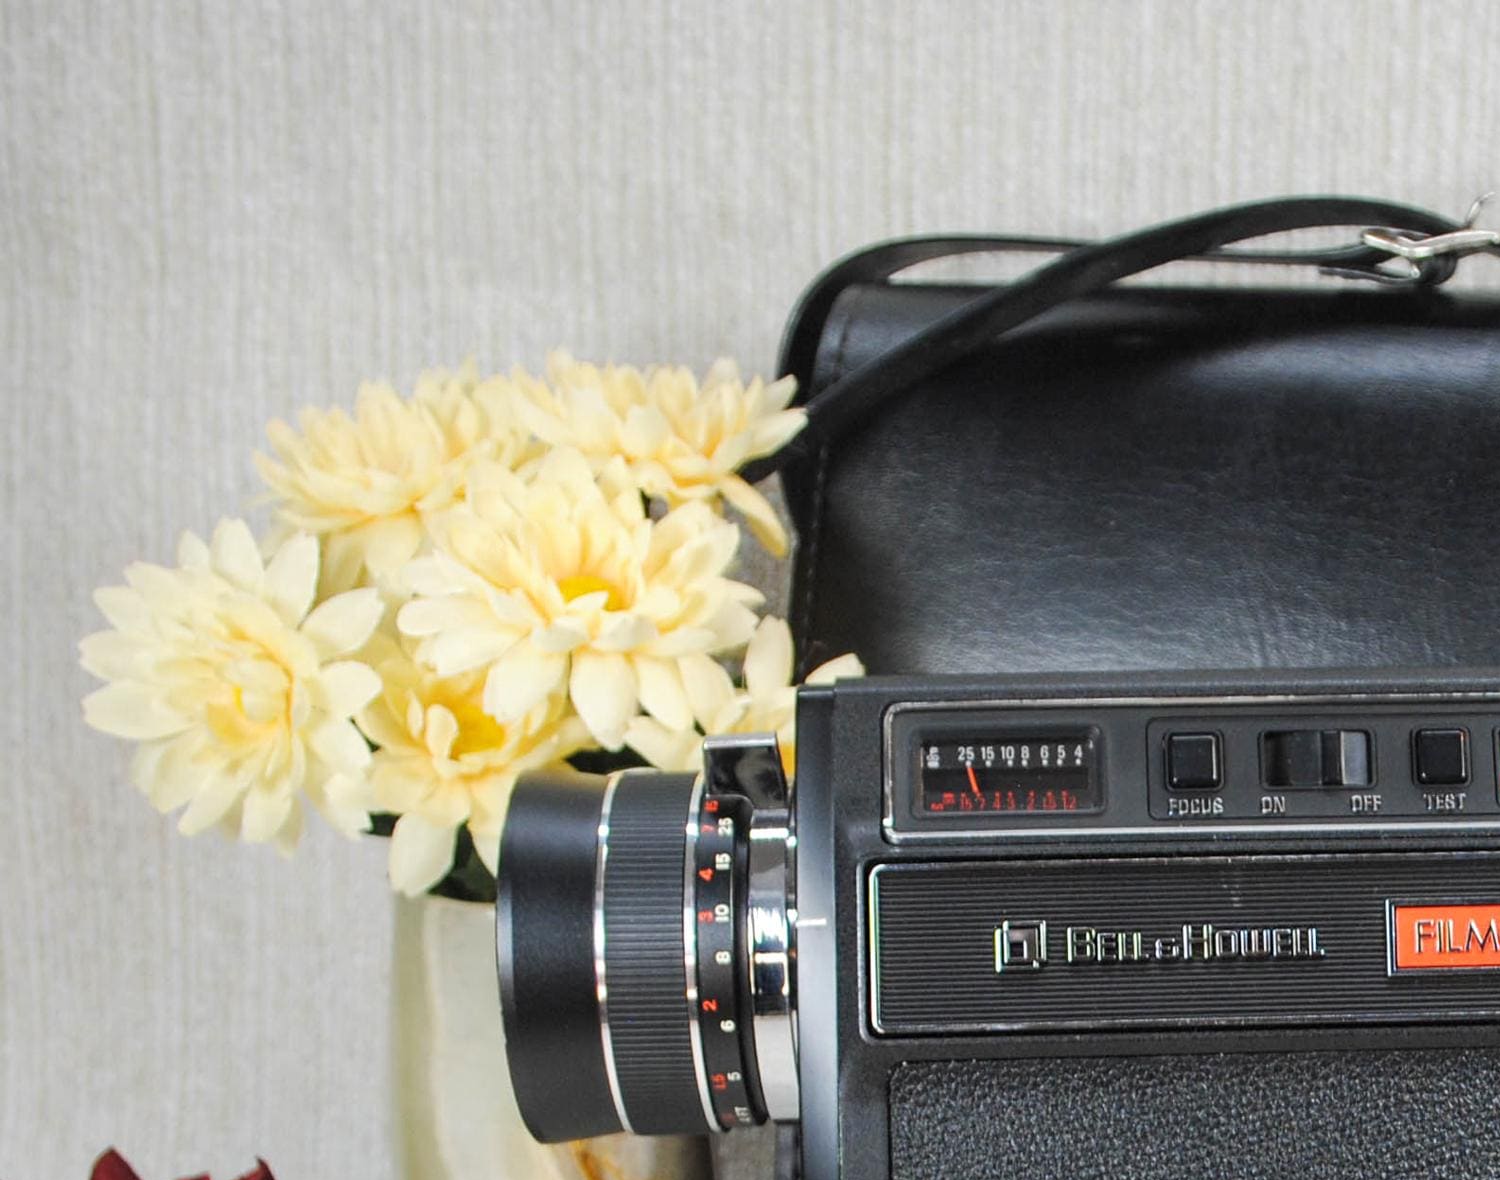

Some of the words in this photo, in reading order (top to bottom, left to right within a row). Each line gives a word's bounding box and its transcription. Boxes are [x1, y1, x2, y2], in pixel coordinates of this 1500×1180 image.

[957, 746, 975, 762] 25
[981, 746, 995, 760] 15
[1001, 745, 1015, 760] 10
[1020, 745, 1030, 760] 8
[1040, 744, 1049, 759] 6
[1057, 744, 1066, 758] 5
[1074, 744, 1083, 758] 4
[1168, 797, 1224, 816] FOCUS
[1260, 796, 1286, 813] ON
[1352, 795, 1382, 812] OFF
[1423, 794, 1467, 811] TEST
[718, 817, 733, 837] 25
[715, 853, 732, 871] 15
[699, 868, 714, 882] 4
[714, 904, 730, 923] 10
[715, 951, 731, 965] 8
[702, 999, 718, 1012] 2
[719, 1019, 736, 1033] 6
[727, 1072, 742, 1082] 5
